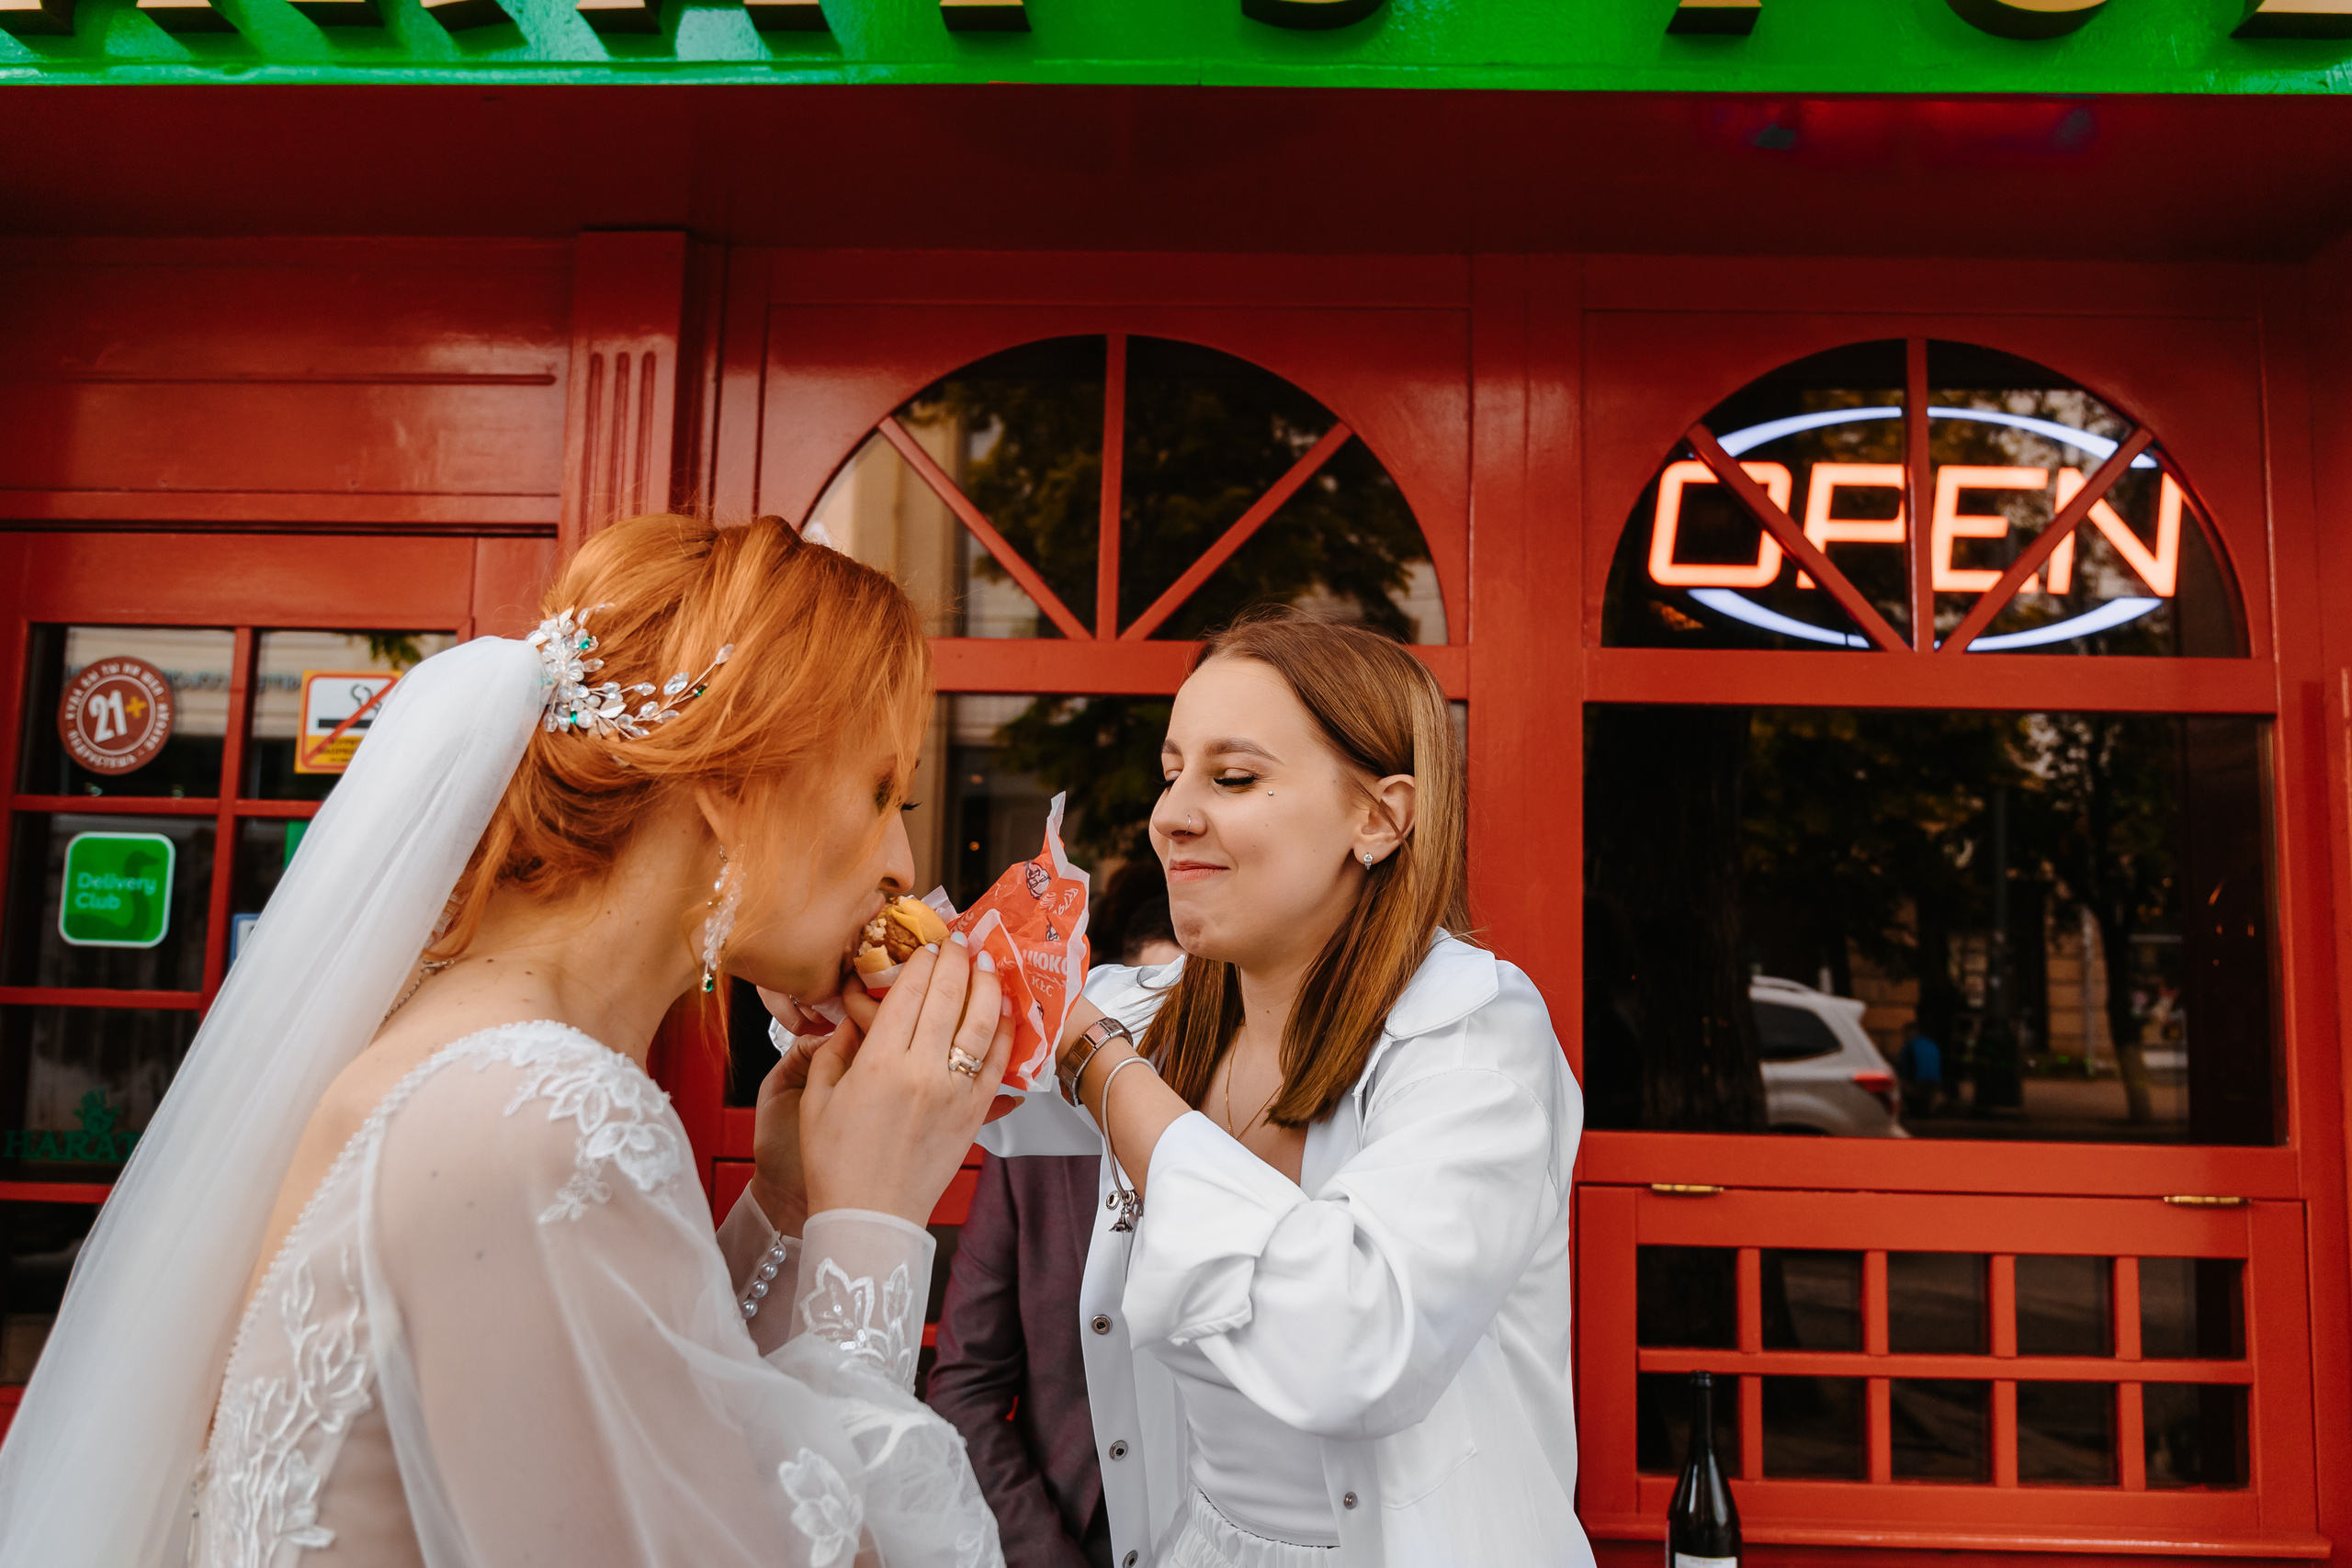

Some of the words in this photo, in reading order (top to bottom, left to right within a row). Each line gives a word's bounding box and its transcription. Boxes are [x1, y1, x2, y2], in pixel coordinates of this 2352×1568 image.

[1647, 459, 2186, 598] OPEN
[88, 689, 148, 744] 21+
[75, 892, 121, 911] Club
[77, 873, 156, 897] Delivery
